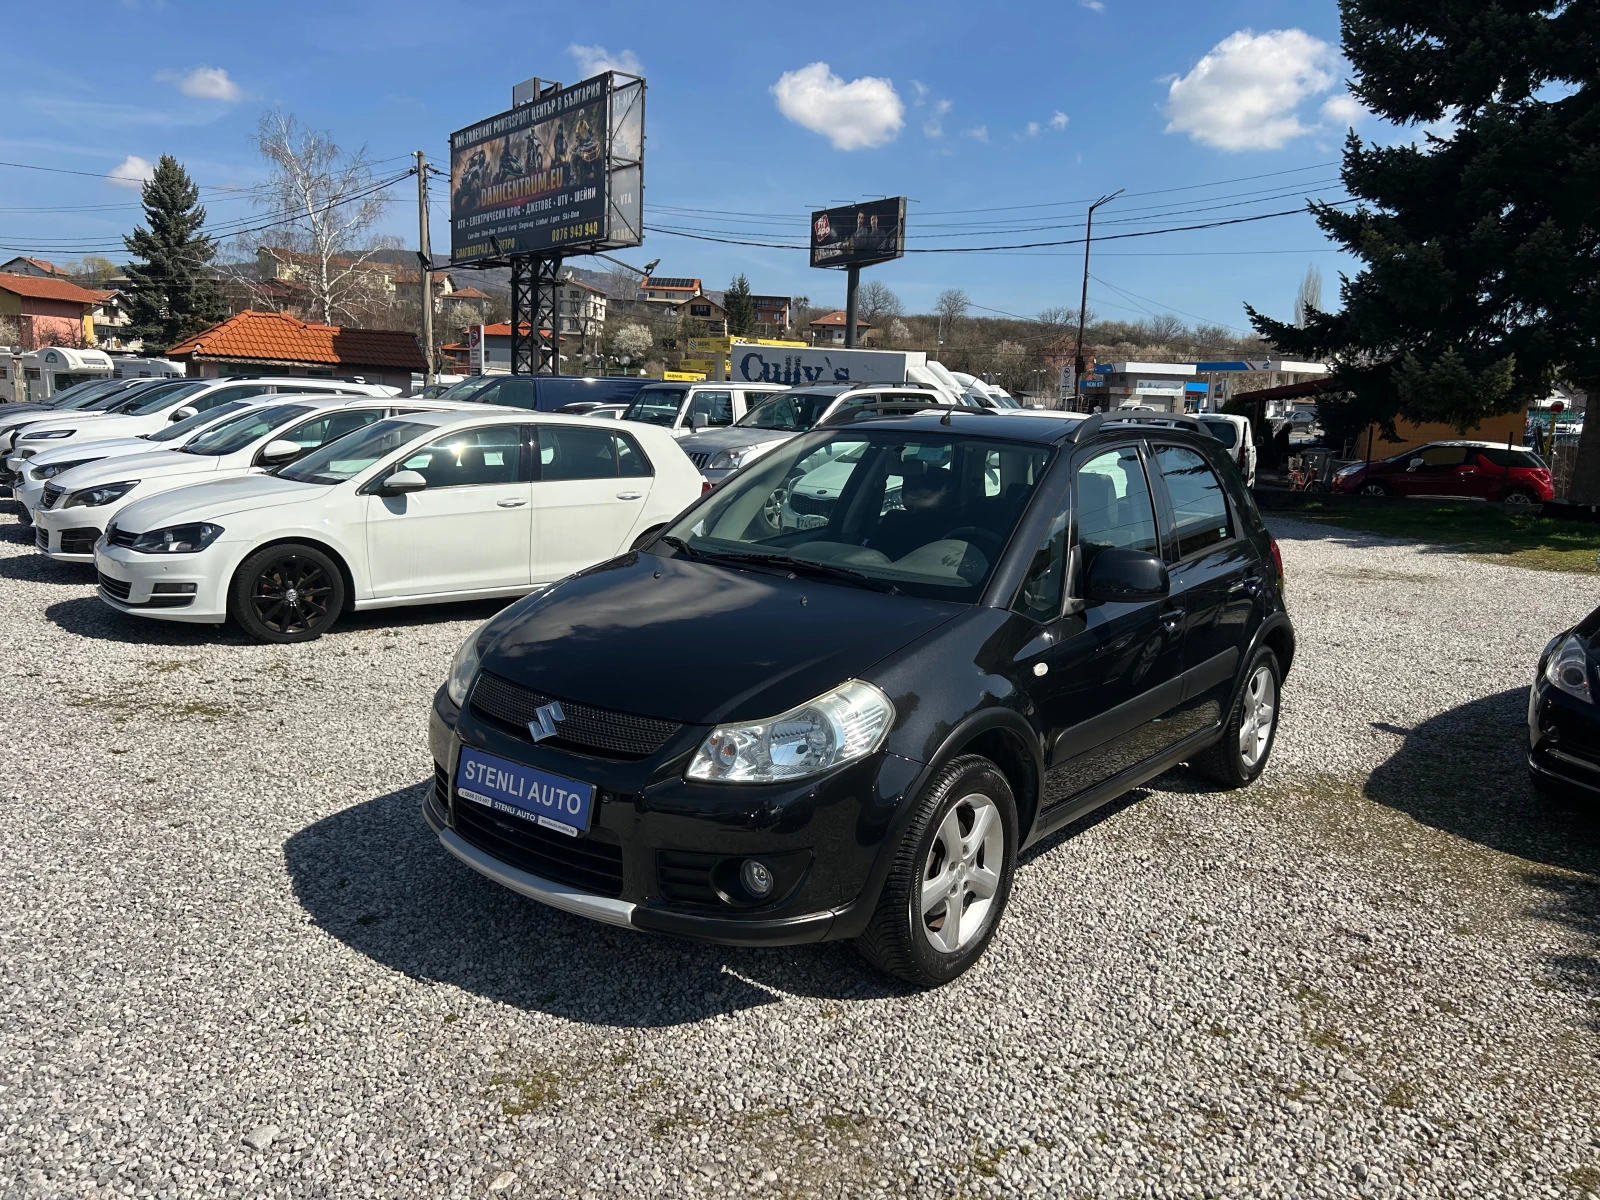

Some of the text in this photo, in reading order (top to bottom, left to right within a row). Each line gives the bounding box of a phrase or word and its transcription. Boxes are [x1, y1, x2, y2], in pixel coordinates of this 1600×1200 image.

[493, 109, 530, 134] POWERSPORT
[531, 100, 556, 121] ЦЕНТЪР
[564, 81, 601, 108] БЪЛГАРИЯ
[469, 208, 506, 227] ЕЛЕКТРИЧЕСКИ
[507, 205, 521, 218] КРОС
[526, 198, 552, 215] ДЖЕТОВЕ
[557, 194, 569, 206] UTV
[574, 187, 597, 202] ШЕЙНИ
[481, 167, 563, 207] DANICENTRUM.EU
[551, 221, 598, 242] 0876 943 940
[465, 760, 581, 815] STENLI AUTO
[494, 801, 536, 821] STENLI AUTO
